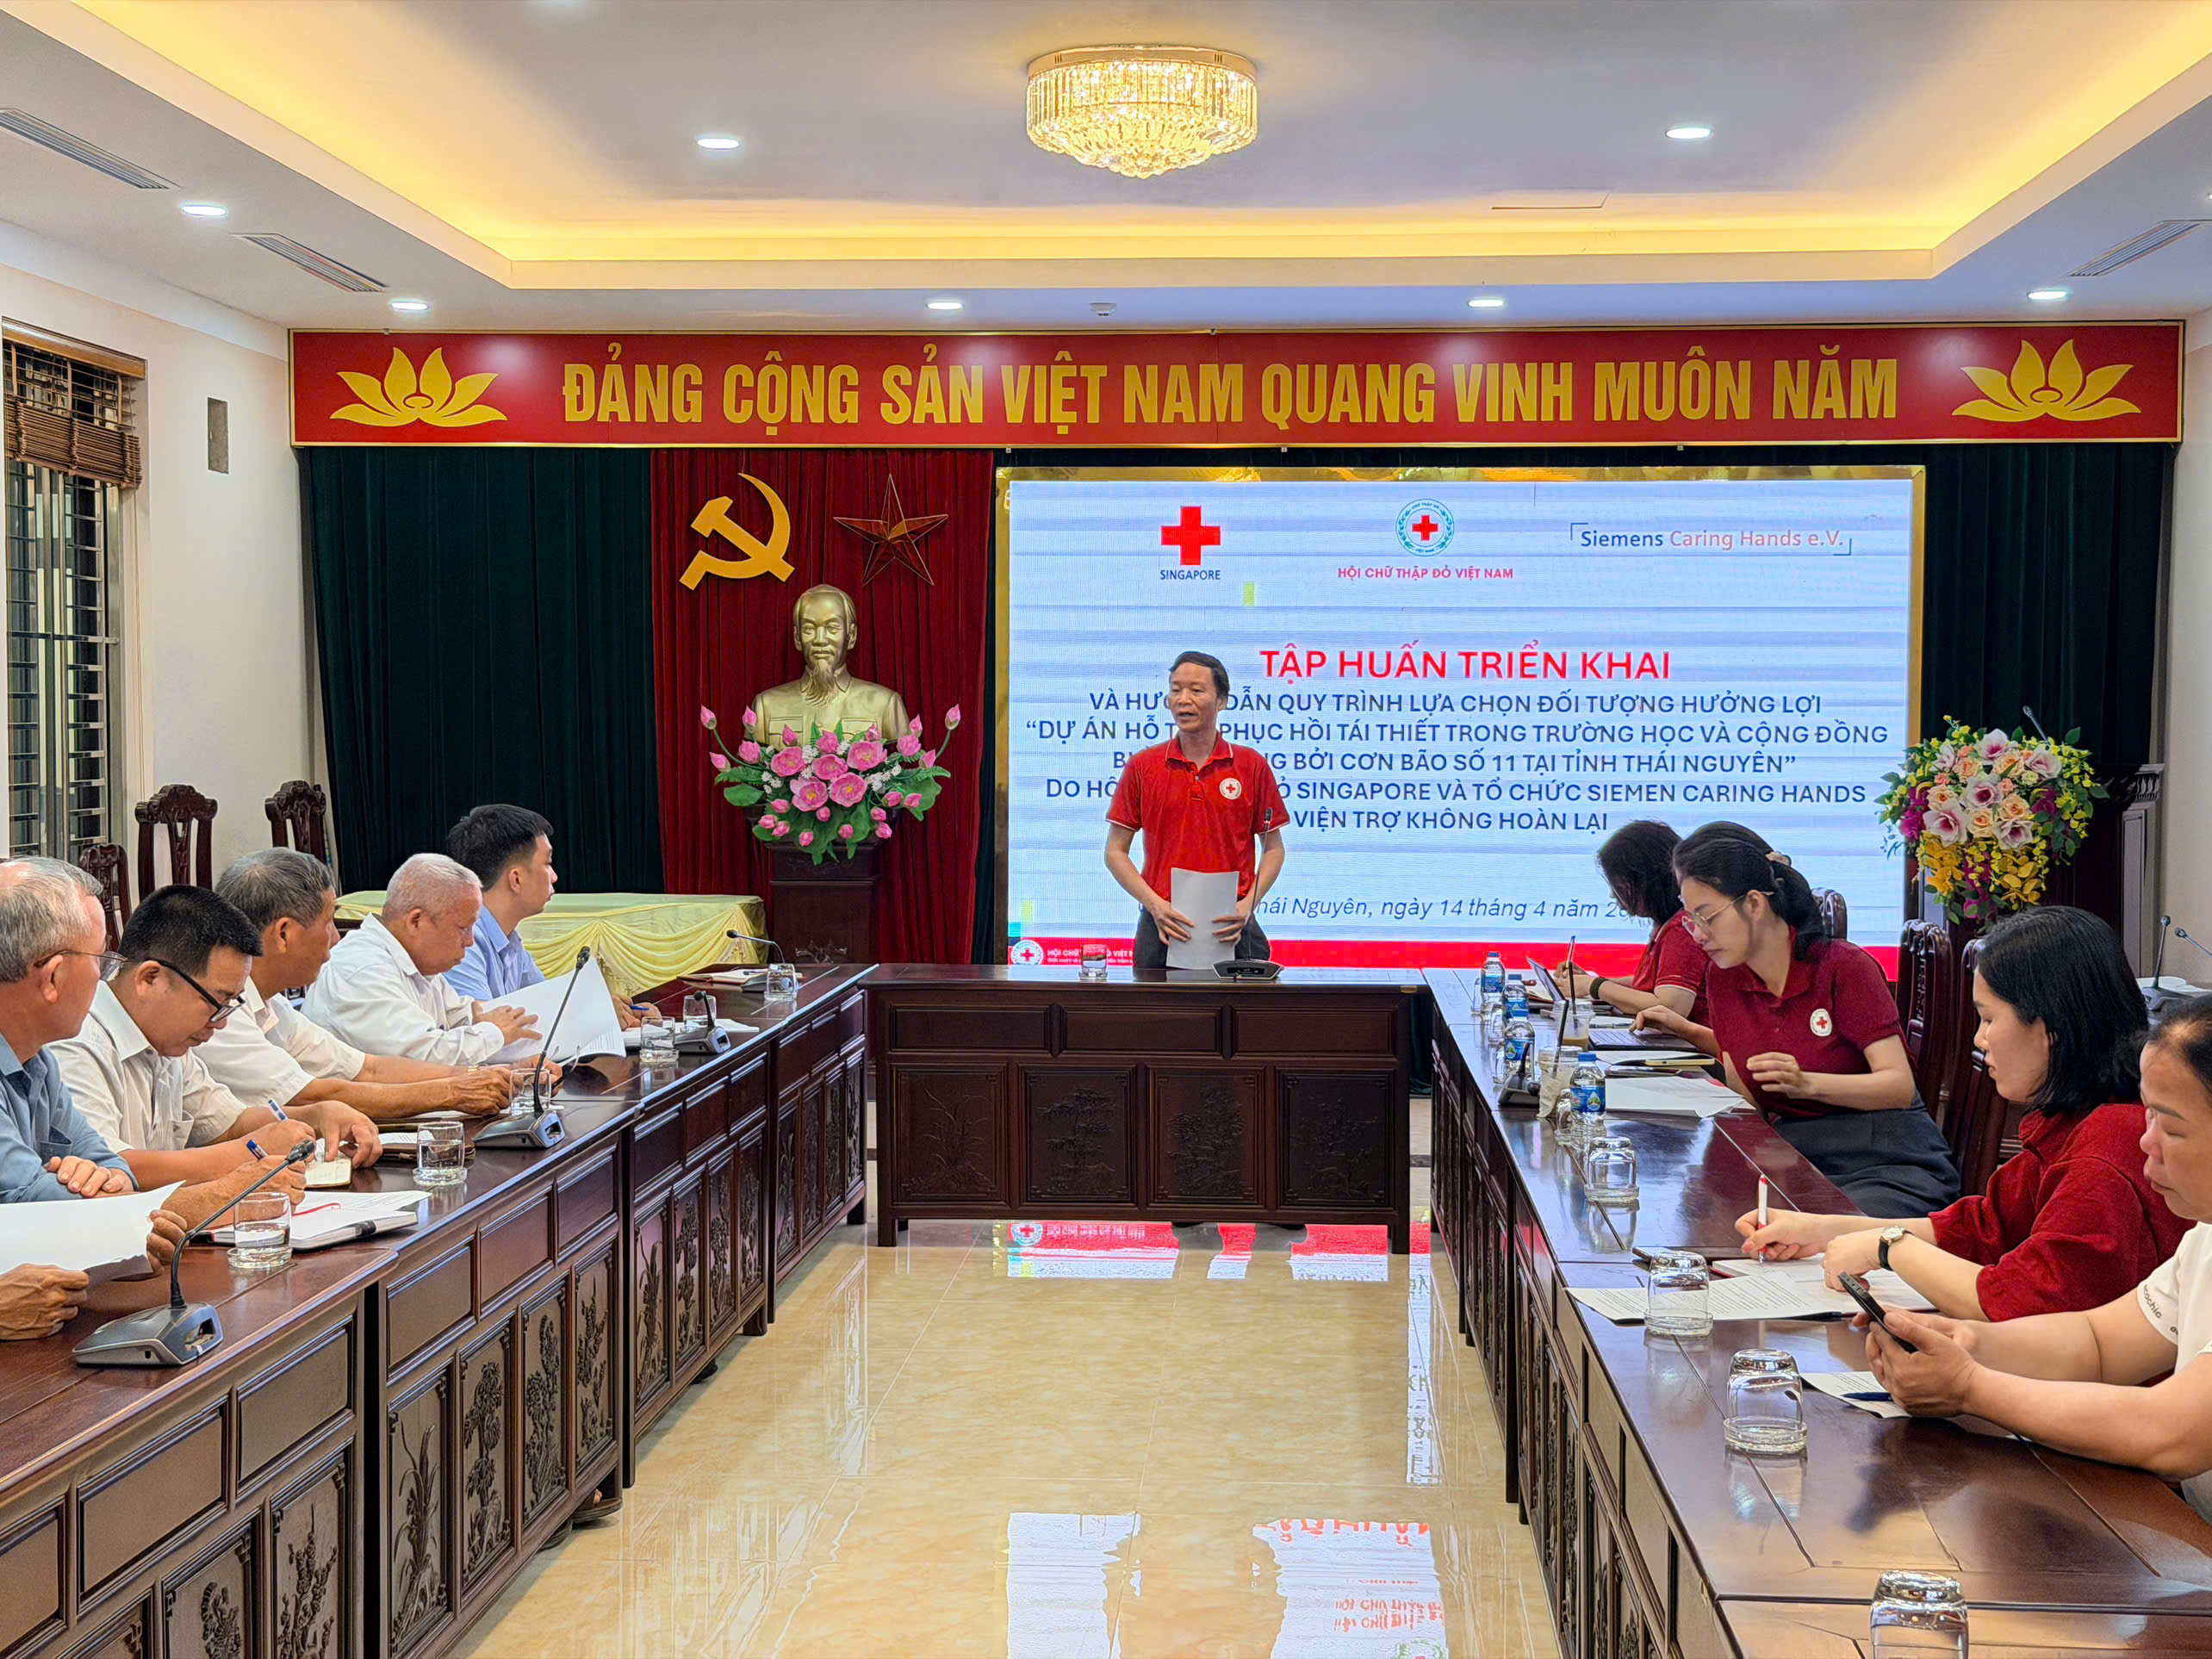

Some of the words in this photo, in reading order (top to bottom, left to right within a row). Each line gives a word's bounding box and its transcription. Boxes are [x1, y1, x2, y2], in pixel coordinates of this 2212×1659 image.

[562, 342, 703, 423] ĐẢNG
[724, 351, 858, 435] CỘNG
[880, 343, 984, 425] SẢN
[1001, 351, 1108, 435] VIỆT
[1124, 365, 1242, 423] NAM
[1263, 365, 1435, 430] QUANG
[1453, 363, 1573, 423] VINH
[1594, 345, 1750, 421] MUÔN
[1773, 345, 1897, 419] NĂM
[1581, 531, 1662, 546] Siemens
[1670, 530, 1733, 550] Caring
[1741, 529, 1801, 546] Hands
[1808, 531, 1842, 545] e.V.
[1160, 570, 1221, 580] SINGAPORE
[1339, 566, 1360, 580] HỘI
[1365, 566, 1393, 578] CHỮ
[1396, 566, 1428, 578] THẬP
[1432, 565, 1451, 578] ĐỎ
[1456, 566, 1480, 578] VIỆT
[1485, 569, 1513, 578] NAM
[1260, 643, 1327, 684] TẬP
[1339, 640, 1446, 679] HUẤN
[1458, 640, 1566, 678] TRIỂN
[1582, 653, 1668, 679] KHAI
[1090, 688, 1119, 710] VÀ
[1227, 686, 1271, 711] DẪN
[1278, 694, 1327, 714] QUY
[1333, 690, 1401, 711] TRÌNH
[1410, 693, 1454, 716] LỰA
[1461, 695, 1530, 717] CHỌN
[1537, 689, 1578, 712] ĐỐI
[1586, 694, 1674, 717] TƯỢNG
[1682, 690, 1774, 712] HƯỞNG
[1783, 695, 1820, 717] LỢI
[1027, 721, 1076, 744] “DỰ
[1082, 716, 1115, 739] ÁN
[1126, 715, 1159, 739] HỖ
[1220, 723, 1283, 743] PHỤC
[1290, 717, 1330, 741] HỒI
[1337, 719, 1369, 741] TÁI
[1376, 718, 1440, 742] THIẾT
[1445, 724, 1525, 743] TRONG
[1532, 720, 1633, 743] TRƯỜNG
[1642, 725, 1693, 746] HỌC
[1700, 721, 1730, 743] VÀ
[1737, 721, 1808, 747] CỘNG
[1815, 719, 1887, 743] ĐỒNG
[1294, 747, 1333, 769] BỞI
[1341, 752, 1393, 770] CƠN
[1401, 749, 1446, 770] BÃO
[1454, 748, 1484, 771] SỐ
[1493, 755, 1514, 771] 11
[1523, 755, 1555, 775] TẠI
[1563, 749, 1616, 772] TỈNH
[1623, 750, 1675, 772] THÁI
[1684, 751, 1795, 773] NGUYÊN”
[1047, 779, 1079, 797] DO
[1297, 782, 1430, 799] SINGAPORE
[1437, 779, 1467, 800] VÀ
[1472, 777, 1501, 800] TỔ
[1509, 780, 1581, 801] CHỨC
[1588, 785, 1675, 801] SIEMEN
[1683, 785, 1774, 802] CARING
[1782, 786, 1865, 802] HANDS
[1294, 806, 1345, 832] VIỆN
[1352, 811, 1401, 832] TRỢ
[1407, 808, 1491, 829] KHÔNG
[1500, 808, 1566, 830] HOÀN
[1575, 813, 1606, 834] LẠI
[1292, 898, 1371, 918] Nguyên,
[1382, 899, 1430, 920] ngày
[1441, 900, 1463, 916] 14
[1469, 898, 1526, 921] tháng
[1533, 901, 1545, 916] 4
[1553, 899, 1598, 916] năm
